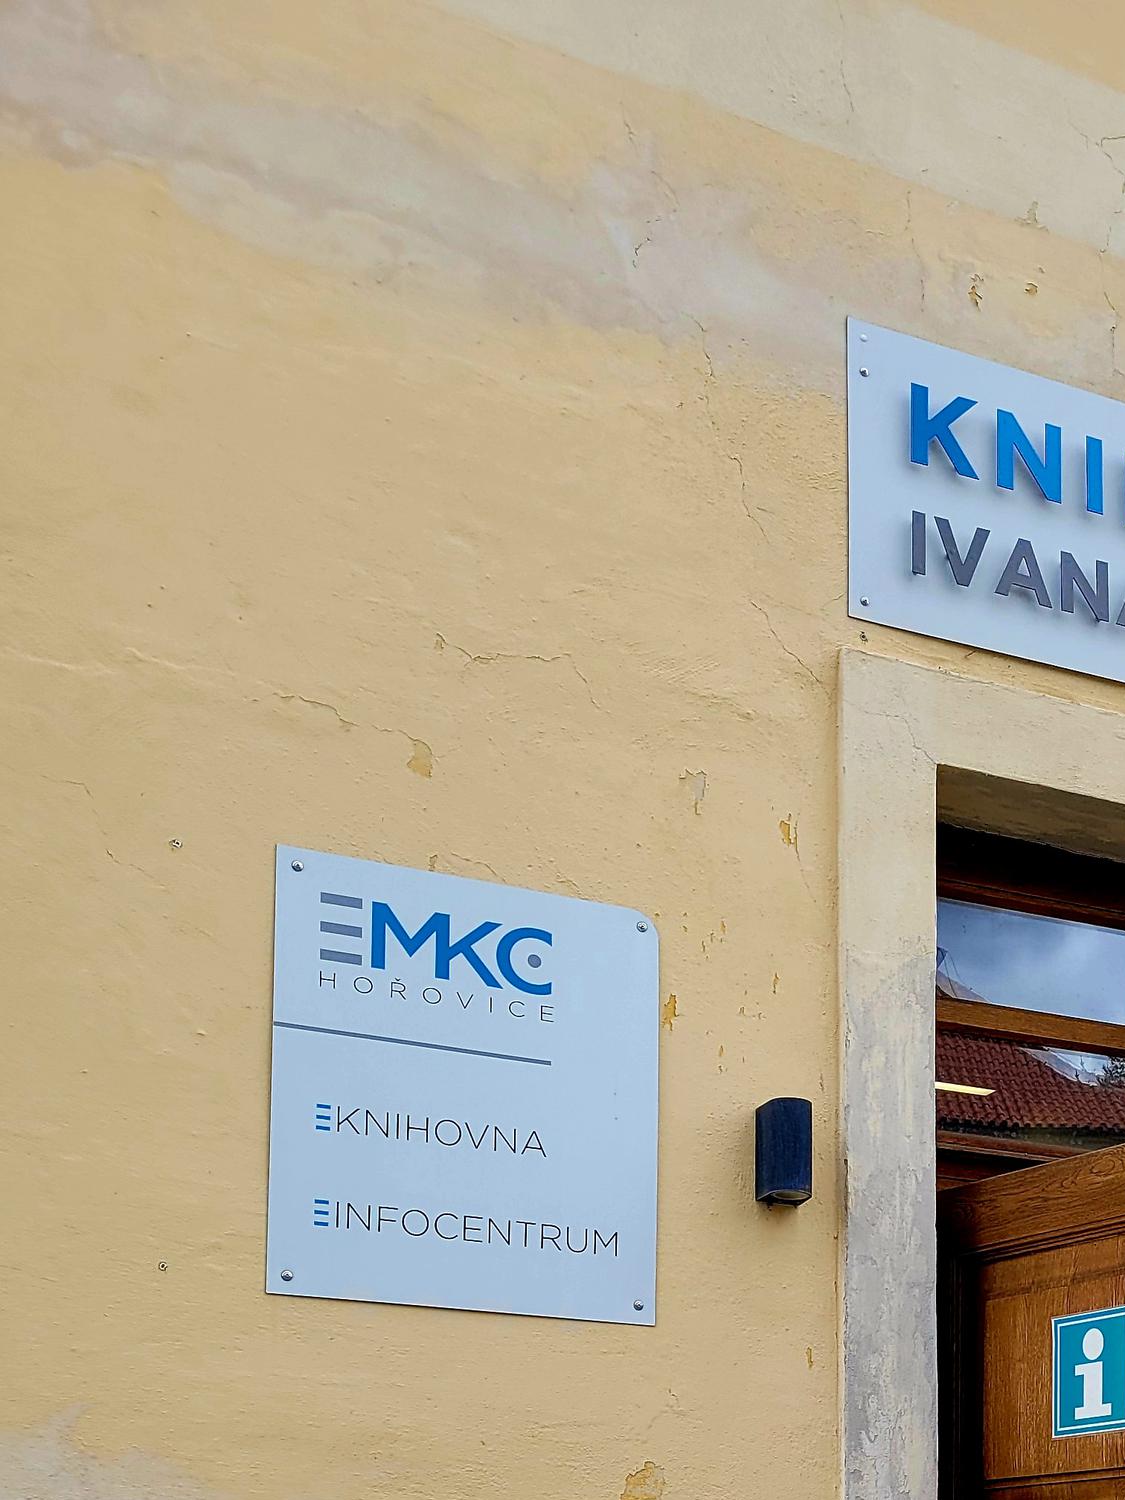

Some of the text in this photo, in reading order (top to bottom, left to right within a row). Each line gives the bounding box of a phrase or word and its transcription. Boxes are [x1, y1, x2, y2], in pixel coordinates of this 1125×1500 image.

[318, 970, 555, 1024] HOŘOVICE
[335, 1105, 548, 1158] KNIHOVNA
[334, 1200, 620, 1258] INFOCENTRUM
